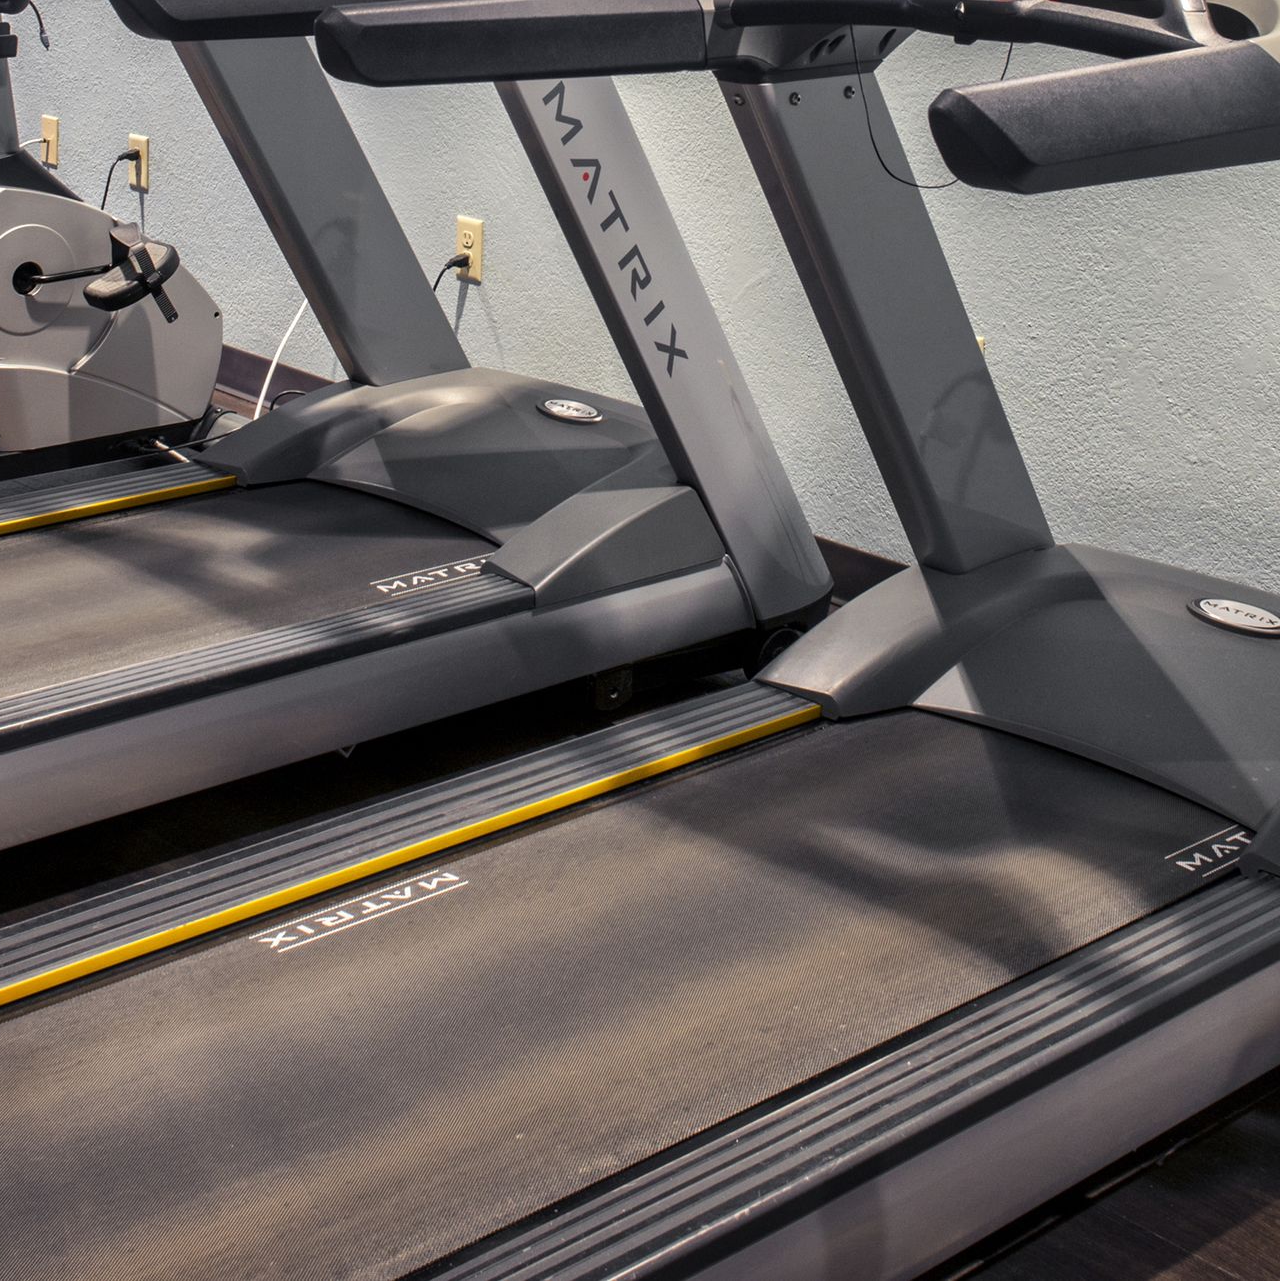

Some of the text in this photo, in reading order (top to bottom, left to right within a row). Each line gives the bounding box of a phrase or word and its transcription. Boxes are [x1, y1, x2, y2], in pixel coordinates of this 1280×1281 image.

[542, 80, 689, 379] MATRIX
[548, 399, 595, 417] MATRIX
[376, 558, 486, 594] MATR
[1203, 599, 1279, 626] MATRIX
[258, 871, 461, 950] MATRIX
